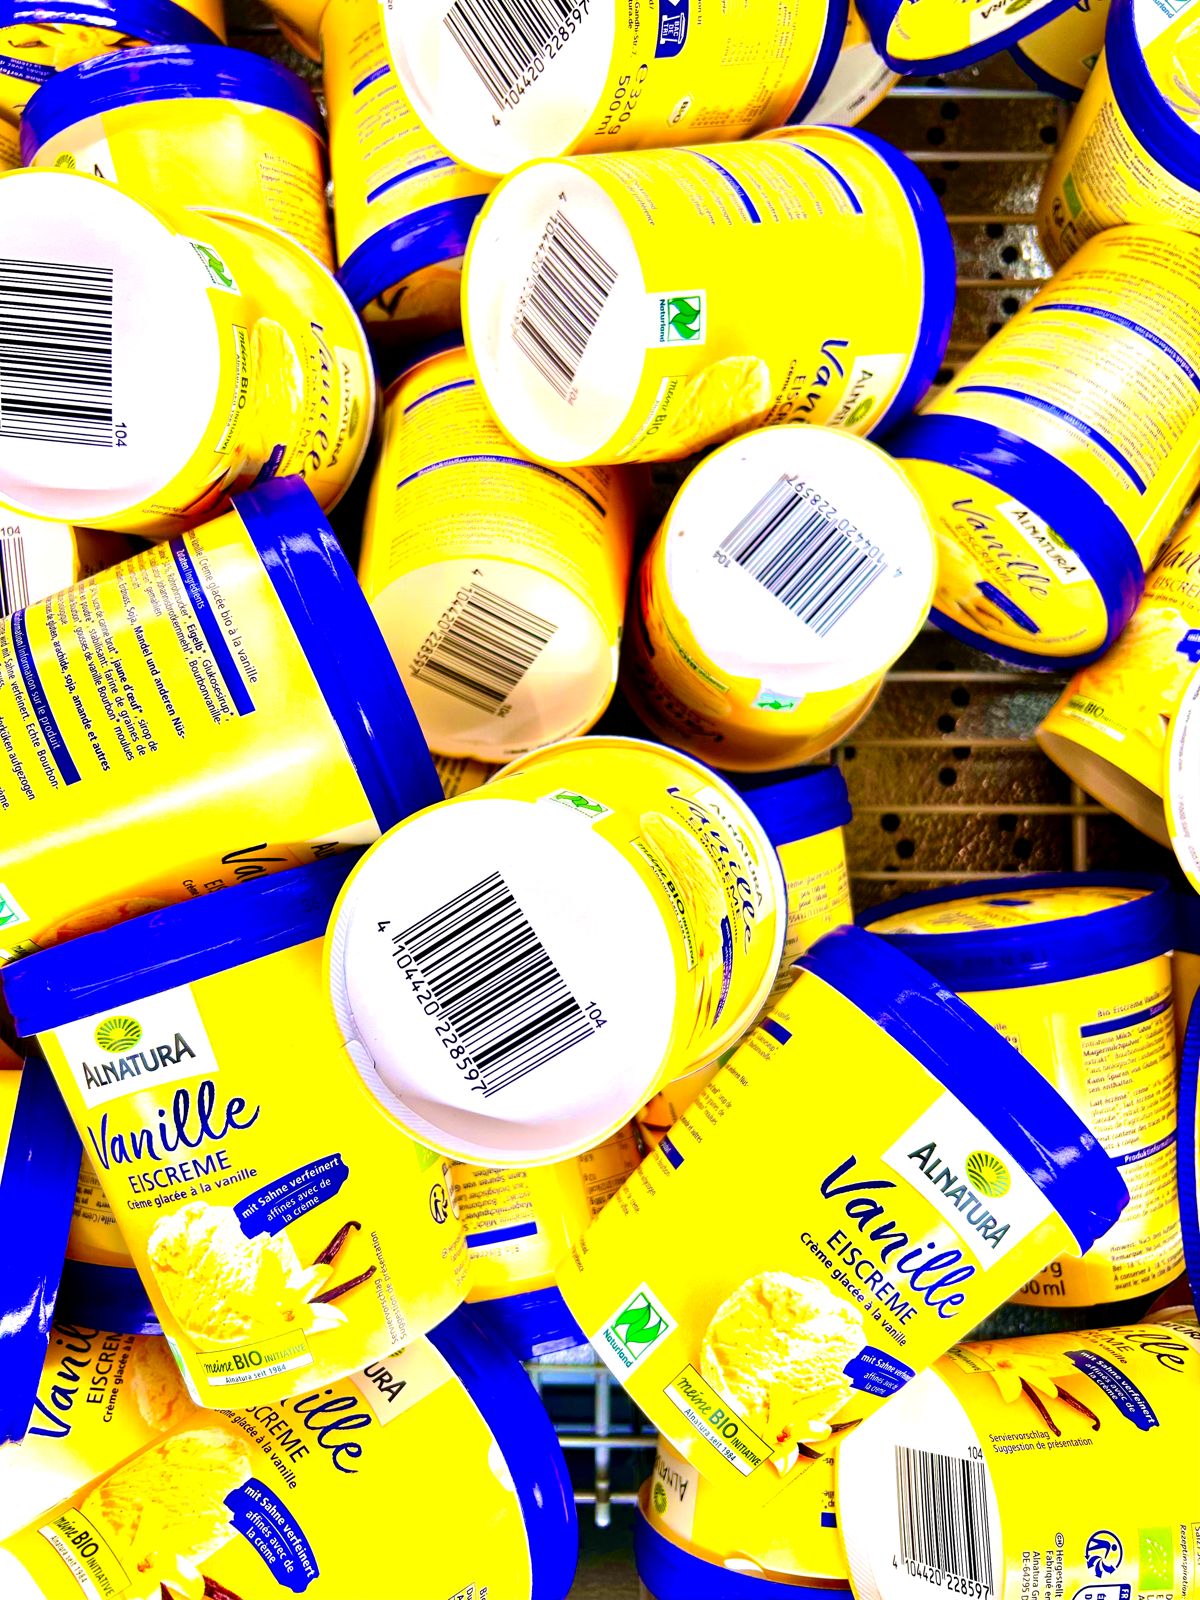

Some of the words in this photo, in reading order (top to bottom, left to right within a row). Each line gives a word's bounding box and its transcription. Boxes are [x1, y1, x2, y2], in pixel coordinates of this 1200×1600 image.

[492, 116, 500, 126] 4
[504, 58, 544, 109] 104420
[545, 0, 589, 59] 228597
[610, 76, 630, 111] 500
[619, 89, 641, 122] 320
[238, 377, 249, 409] BIO
[115, 422, 127, 447] 104
[0, 526, 21, 537] 104
[951, 499, 1050, 602] Vanille
[1013, 511, 1077, 575] ALNATURA
[205, 580, 228, 610] glacée
[220, 609, 234, 627] bio
[227, 626, 238, 636] à
[72, 626, 89, 652] gousses
[83, 650, 94, 661] de
[86, 628, 110, 668] stabilisant:
[231, 635, 243, 647] la
[2, 658, 18, 680] Sahne
[86, 660, 104, 686] vanille
[103, 668, 120, 694] farine
[124, 606, 139, 626] Soja,
[132, 625, 152, 657] Mandel
[145, 657, 159, 675] und
[153, 676, 176, 716] anderen
[171, 716, 187, 740] Nüs-
[236, 647, 260, 684] vanille
[8, 680, 32, 722] verfeinert.
[30, 690, 42, 704] sur
[36, 705, 46, 715] le
[49, 640, 71, 673] arachide,
[62, 673, 77, 693] soja,
[71, 694, 92, 730] amande
[86, 730, 97, 741] et
[92, 741, 110, 772] autres
[111, 658, 128, 683] jaune
[135, 717, 153, 741] sirop
[147, 739, 158, 752] de
[114, 695, 126, 708] de
[187, 659, 222, 726] Bourbonvanille-
[25, 722, 42, 748] Echte
[38, 715, 60, 750] produit
[113, 725, 135, 761] moulues
[118, 708, 140, 742] graines
[135, 743, 146, 756] de
[9, 753, 36, 800] aufgezogen
[36, 749, 60, 791] Bourbon-
[636, 843, 667, 878] meine
[666, 881, 685, 915] BIO
[666, 787, 755, 955] Vanille
[377, 920, 391, 932] 4
[392, 945, 440, 1016] 104420
[435, 1021, 487, 1091] 228597
[585, 1001, 607, 1028] 104
[82, 1032, 196, 1090] ALNATURA
[87, 1080, 260, 1170] Vanille
[127, 1200, 152, 1210] Crème
[155, 1189, 187, 1208] glacée
[200, 1182, 212, 1193] la
[215, 1167, 257, 1188] vanille
[128, 1150, 232, 1194] EISCREME
[242, 1200, 258, 1219] mit
[257, 1183, 290, 1207] Sahne
[290, 1157, 339, 1187] verfeinert
[266, 1198, 297, 1222] affinés
[297, 1186, 319, 1201] avec
[320, 1177, 331, 1188] de
[282, 1211, 292, 1223] la
[293, 1195, 319, 1216] crème
[907, 1142, 1011, 1250] ALNATURA
[371, 1231, 391, 1281] présentation
[821, 1155, 976, 1319] Vanille
[383, 1282, 391, 1293] de
[801, 1232, 833, 1269] Crème
[831, 1269, 865, 1303] glacée
[864, 1301, 873, 1311] à
[871, 1309, 881, 1320] la
[881, 1319, 907, 1347] vanille
[827, 1229, 918, 1326] EISCREME
[1044, 1279, 1065, 1296] ml
[374, 1279, 398, 1345] Serviervorschlag
[387, 1295, 407, 1340] Suggestion
[204, 1355, 234, 1375] meine
[233, 1350, 263, 1371] BIO
[264, 1344, 306, 1364] INITIATIVE
[603, 1329, 633, 1368] Naturland
[861, 1354, 876, 1364] mit
[875, 1359, 896, 1373] Sahne
[103, 1388, 119, 1422] Crème
[114, 1354, 129, 1385] glacée
[254, 1369, 266, 1377] seit
[269, 1363, 286, 1374] 1984
[1080, 1351, 1097, 1361] mit
[1097, 1360, 1122, 1380] Sahne
[1121, 1380, 1155, 1424] verfeinert
[1085, 1362, 1110, 1382] affinés
[1110, 1384, 1127, 1401] avec
[1125, 1402, 1136, 1413] de
[1088, 1372, 1097, 1380] la
[1097, 1378, 1118, 1400] crème
[677, 1376, 713, 1415] meine
[708, 1408, 739, 1439] BIO
[731, 1437, 762, 1466] INITIATIVE
[683, 1408, 710, 1437] Alnatura
[709, 1434, 722, 1450] seit
[721, 1447, 737, 1462] 1984
[989, 1431, 1051, 1442] Serviervorschlag
[234, 1414, 258, 1438] glacée
[256, 1435, 264, 1444] à
[261, 1441, 272, 1453] la
[270, 1453, 297, 1490] vanille
[968, 1447, 984, 1460] 104
[993, 1442, 1035, 1455] Suggestion
[1037, 1442, 1046, 1450] de
[1047, 1437, 1093, 1452] présentation
[244, 1486, 262, 1502] mit
[260, 1497, 285, 1526] Sahne
[283, 1525, 316, 1577] verfeinert
[246, 1510, 272, 1537] affinés
[269, 1537, 287, 1560] avec
[283, 1559, 294, 1573] de
[246, 1527, 255, 1540] la
[255, 1537, 276, 1564] crème
[52, 1515, 78, 1539] meine
[72, 1530, 99, 1558] BIO
[86, 1558, 115, 1597] INITIATIVE
[74, 1563, 89, 1584] 1984
[1022, 1551, 1030, 1592] DE-64295
[1045, 1550, 1053, 1588] Fabriqué
[1055, 1550, 1063, 1597] Hergestellt
[906, 1560, 942, 1586] 104420
[946, 1574, 990, 1600] 228597
[1121, 1588, 1129, 1599] FR
